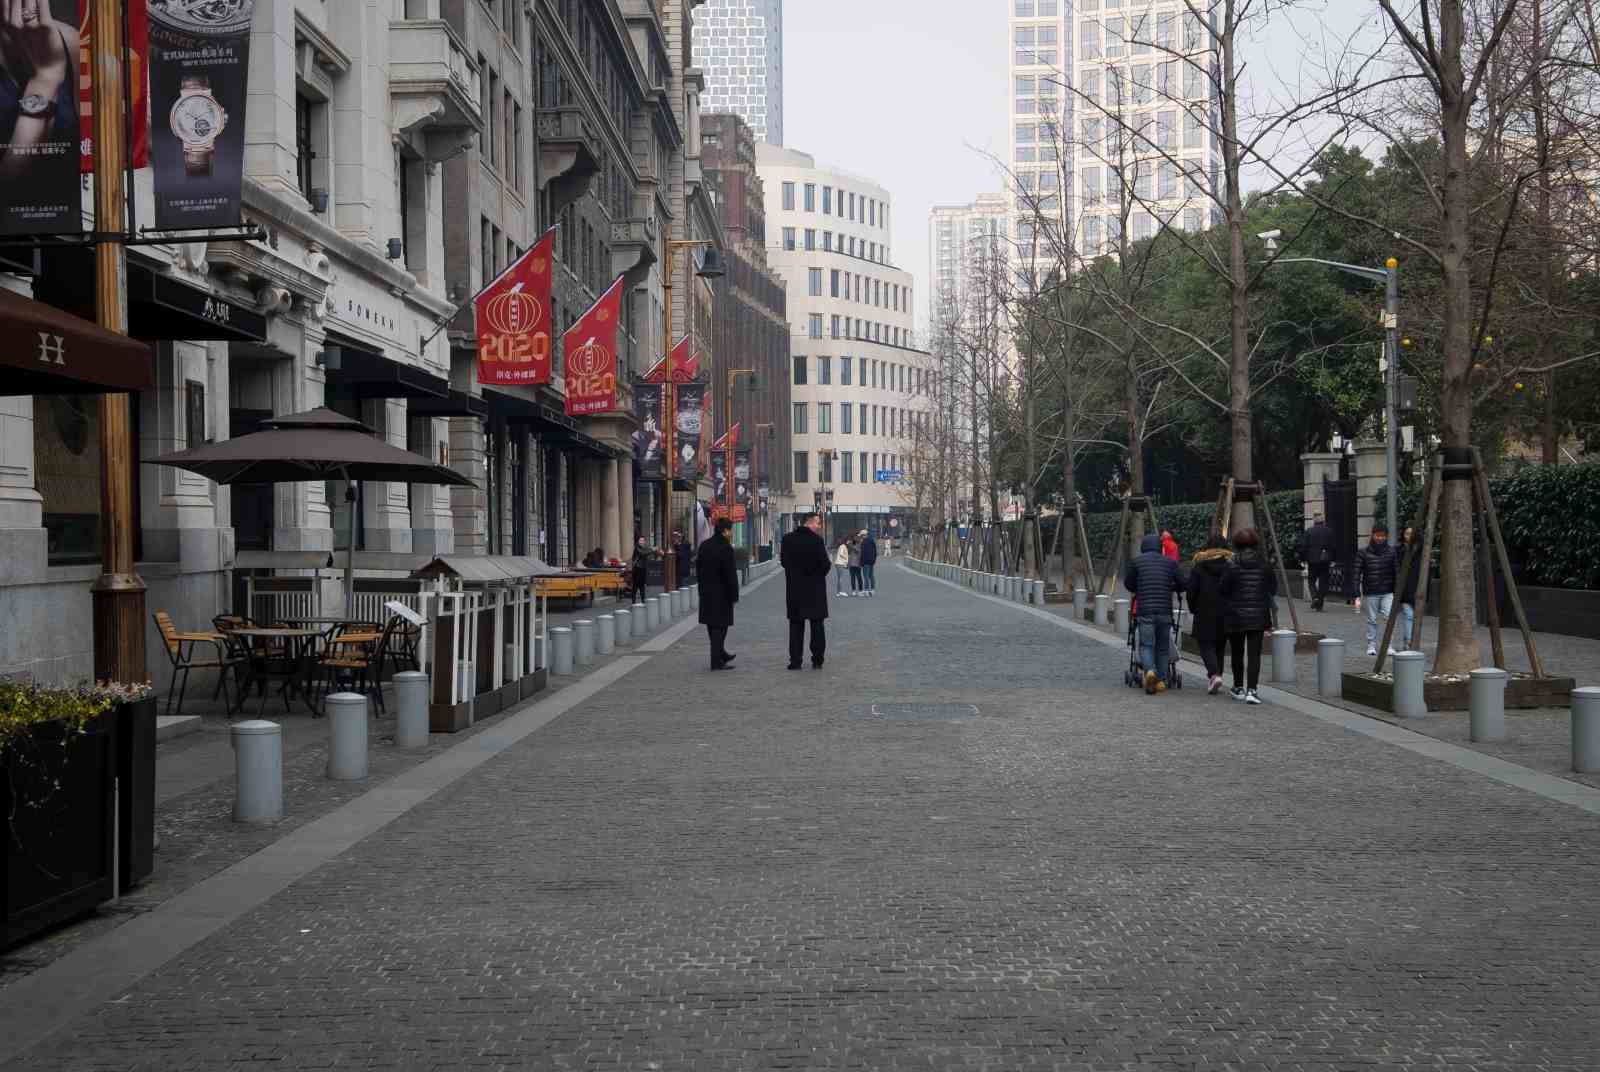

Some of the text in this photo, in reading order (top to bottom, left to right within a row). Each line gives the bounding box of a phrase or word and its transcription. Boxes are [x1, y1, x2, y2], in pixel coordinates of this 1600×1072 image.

[38, 331, 65, 365] H
[480, 331, 549, 362] 2020
[565, 371, 615, 397] 2020
